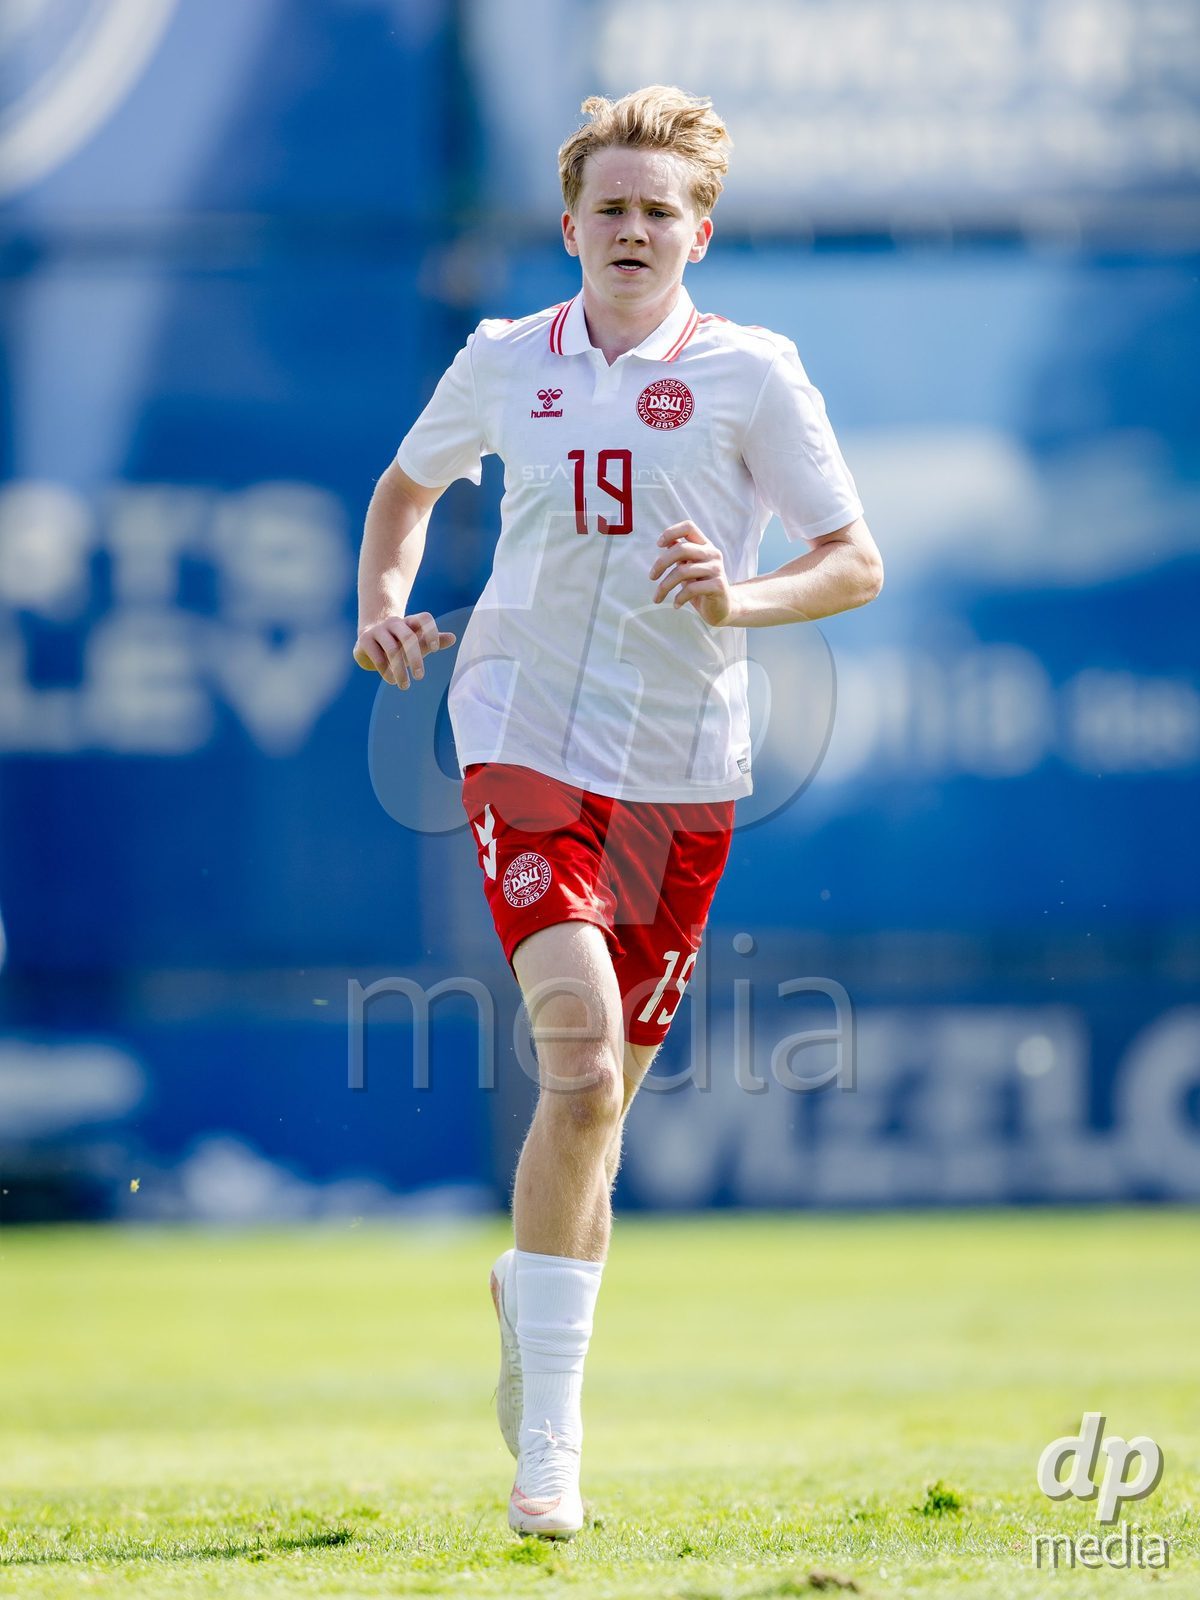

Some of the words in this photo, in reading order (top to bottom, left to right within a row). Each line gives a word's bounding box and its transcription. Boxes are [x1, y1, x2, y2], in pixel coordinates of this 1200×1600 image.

[531, 409, 563, 418] hummel
[648, 395, 682, 411] DBU
[677, 396, 692, 424] UNION
[651, 420, 675, 428] 1889
[568, 449, 633, 535] 19
[511, 866, 540, 893] DBU
[637, 951, 697, 1025] 19
